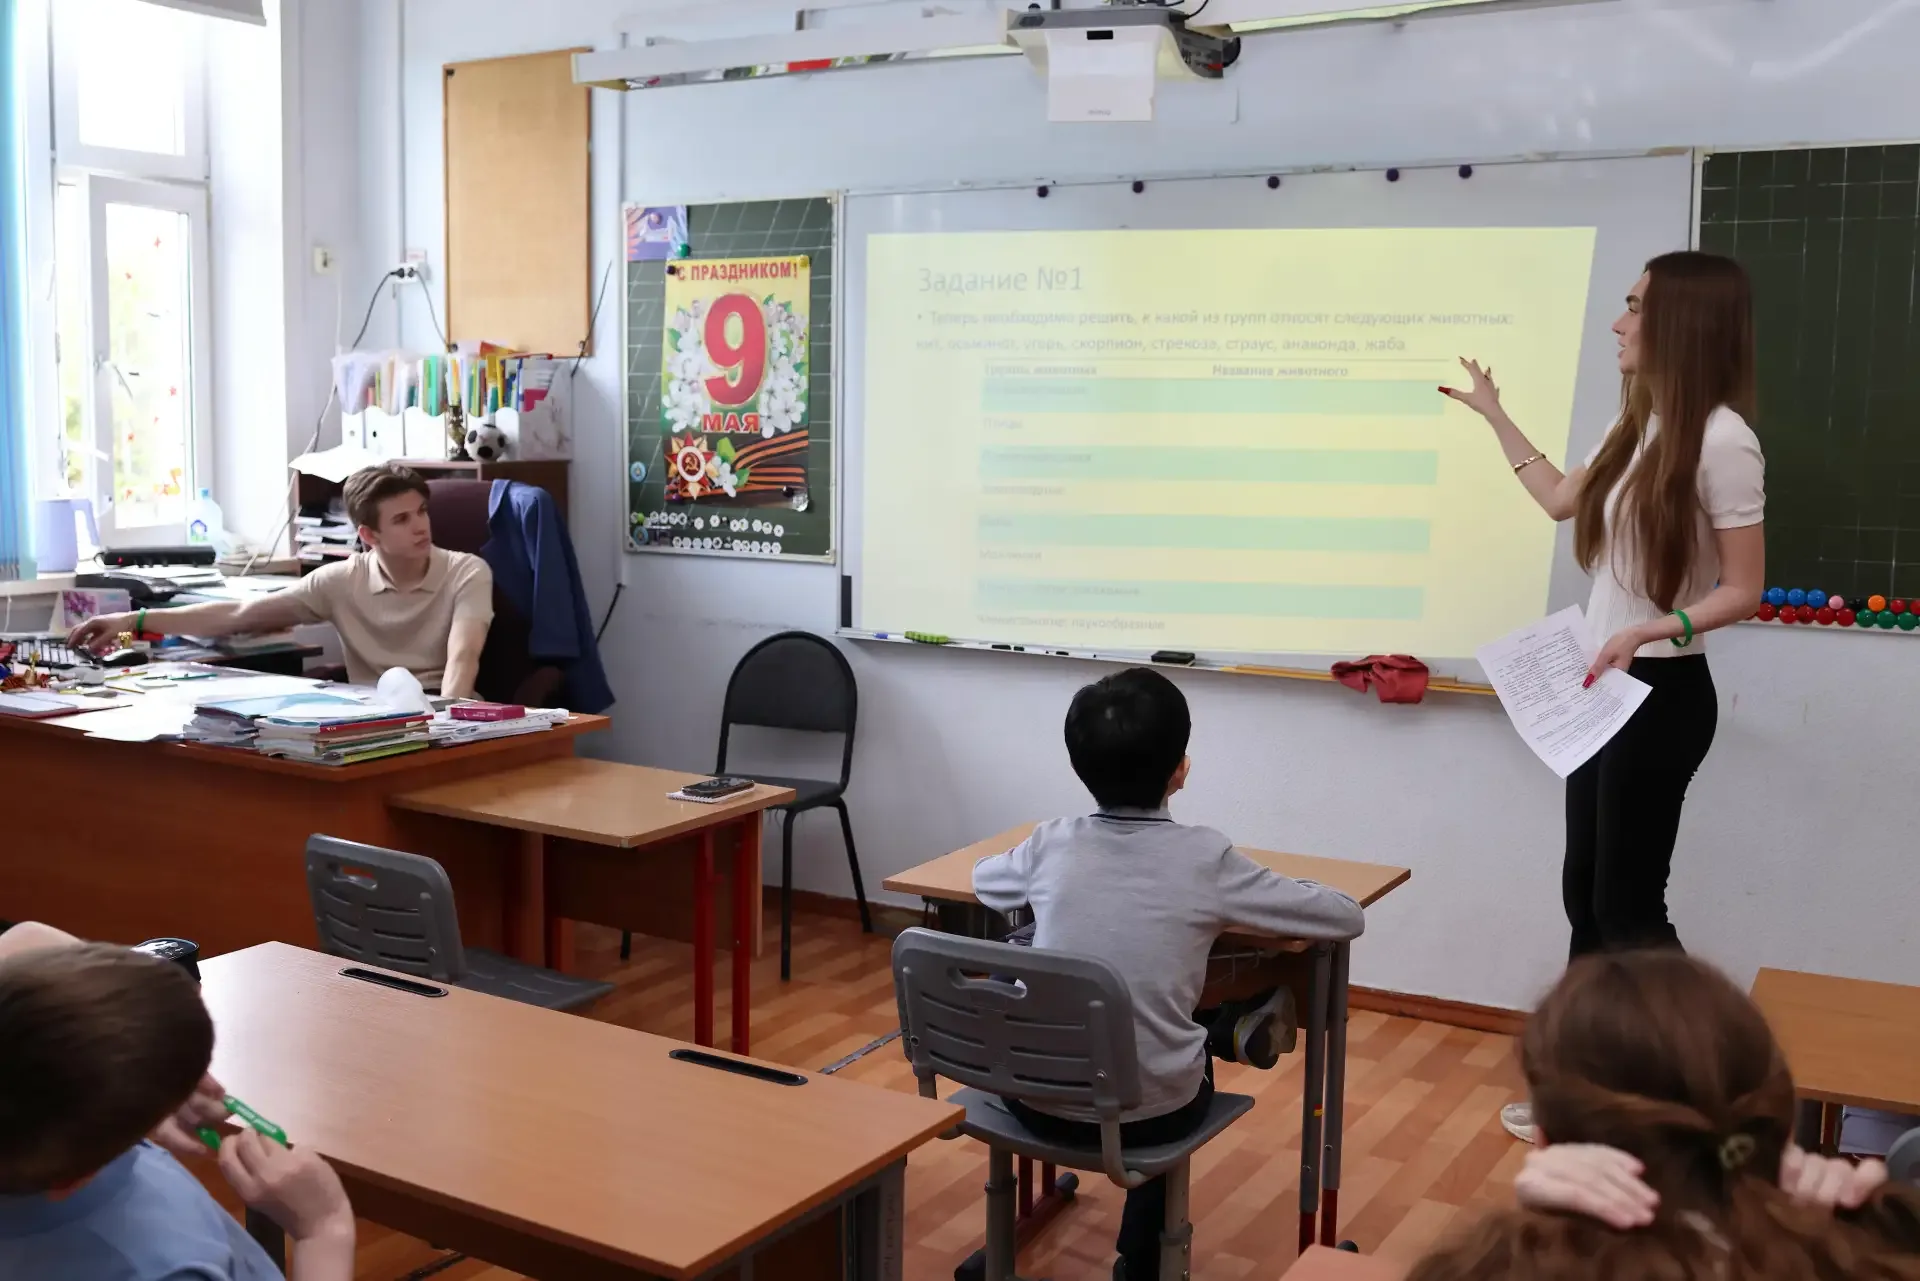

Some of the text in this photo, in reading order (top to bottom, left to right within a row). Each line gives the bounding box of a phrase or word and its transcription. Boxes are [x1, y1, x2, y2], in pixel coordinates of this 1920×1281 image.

[691, 261, 799, 284] ПРАЗДНИКОМ!
[918, 265, 1084, 296] Задание №1
[1079, 313, 1137, 327] решить,
[1156, 309, 1198, 325] какой
[1203, 313, 1219, 325] из
[1224, 313, 1268, 328] групп
[1335, 313, 1424, 328] следующих
[703, 292, 767, 406] 9
[1071, 339, 1147, 355] скорпион,
[1151, 339, 1221, 355] стрекоза,
[1226, 340, 1277, 356] страус,
[1282, 340, 1360, 355] анаконда,
[1364, 337, 1407, 354] жаба
[702, 411, 761, 433] МАЯ
